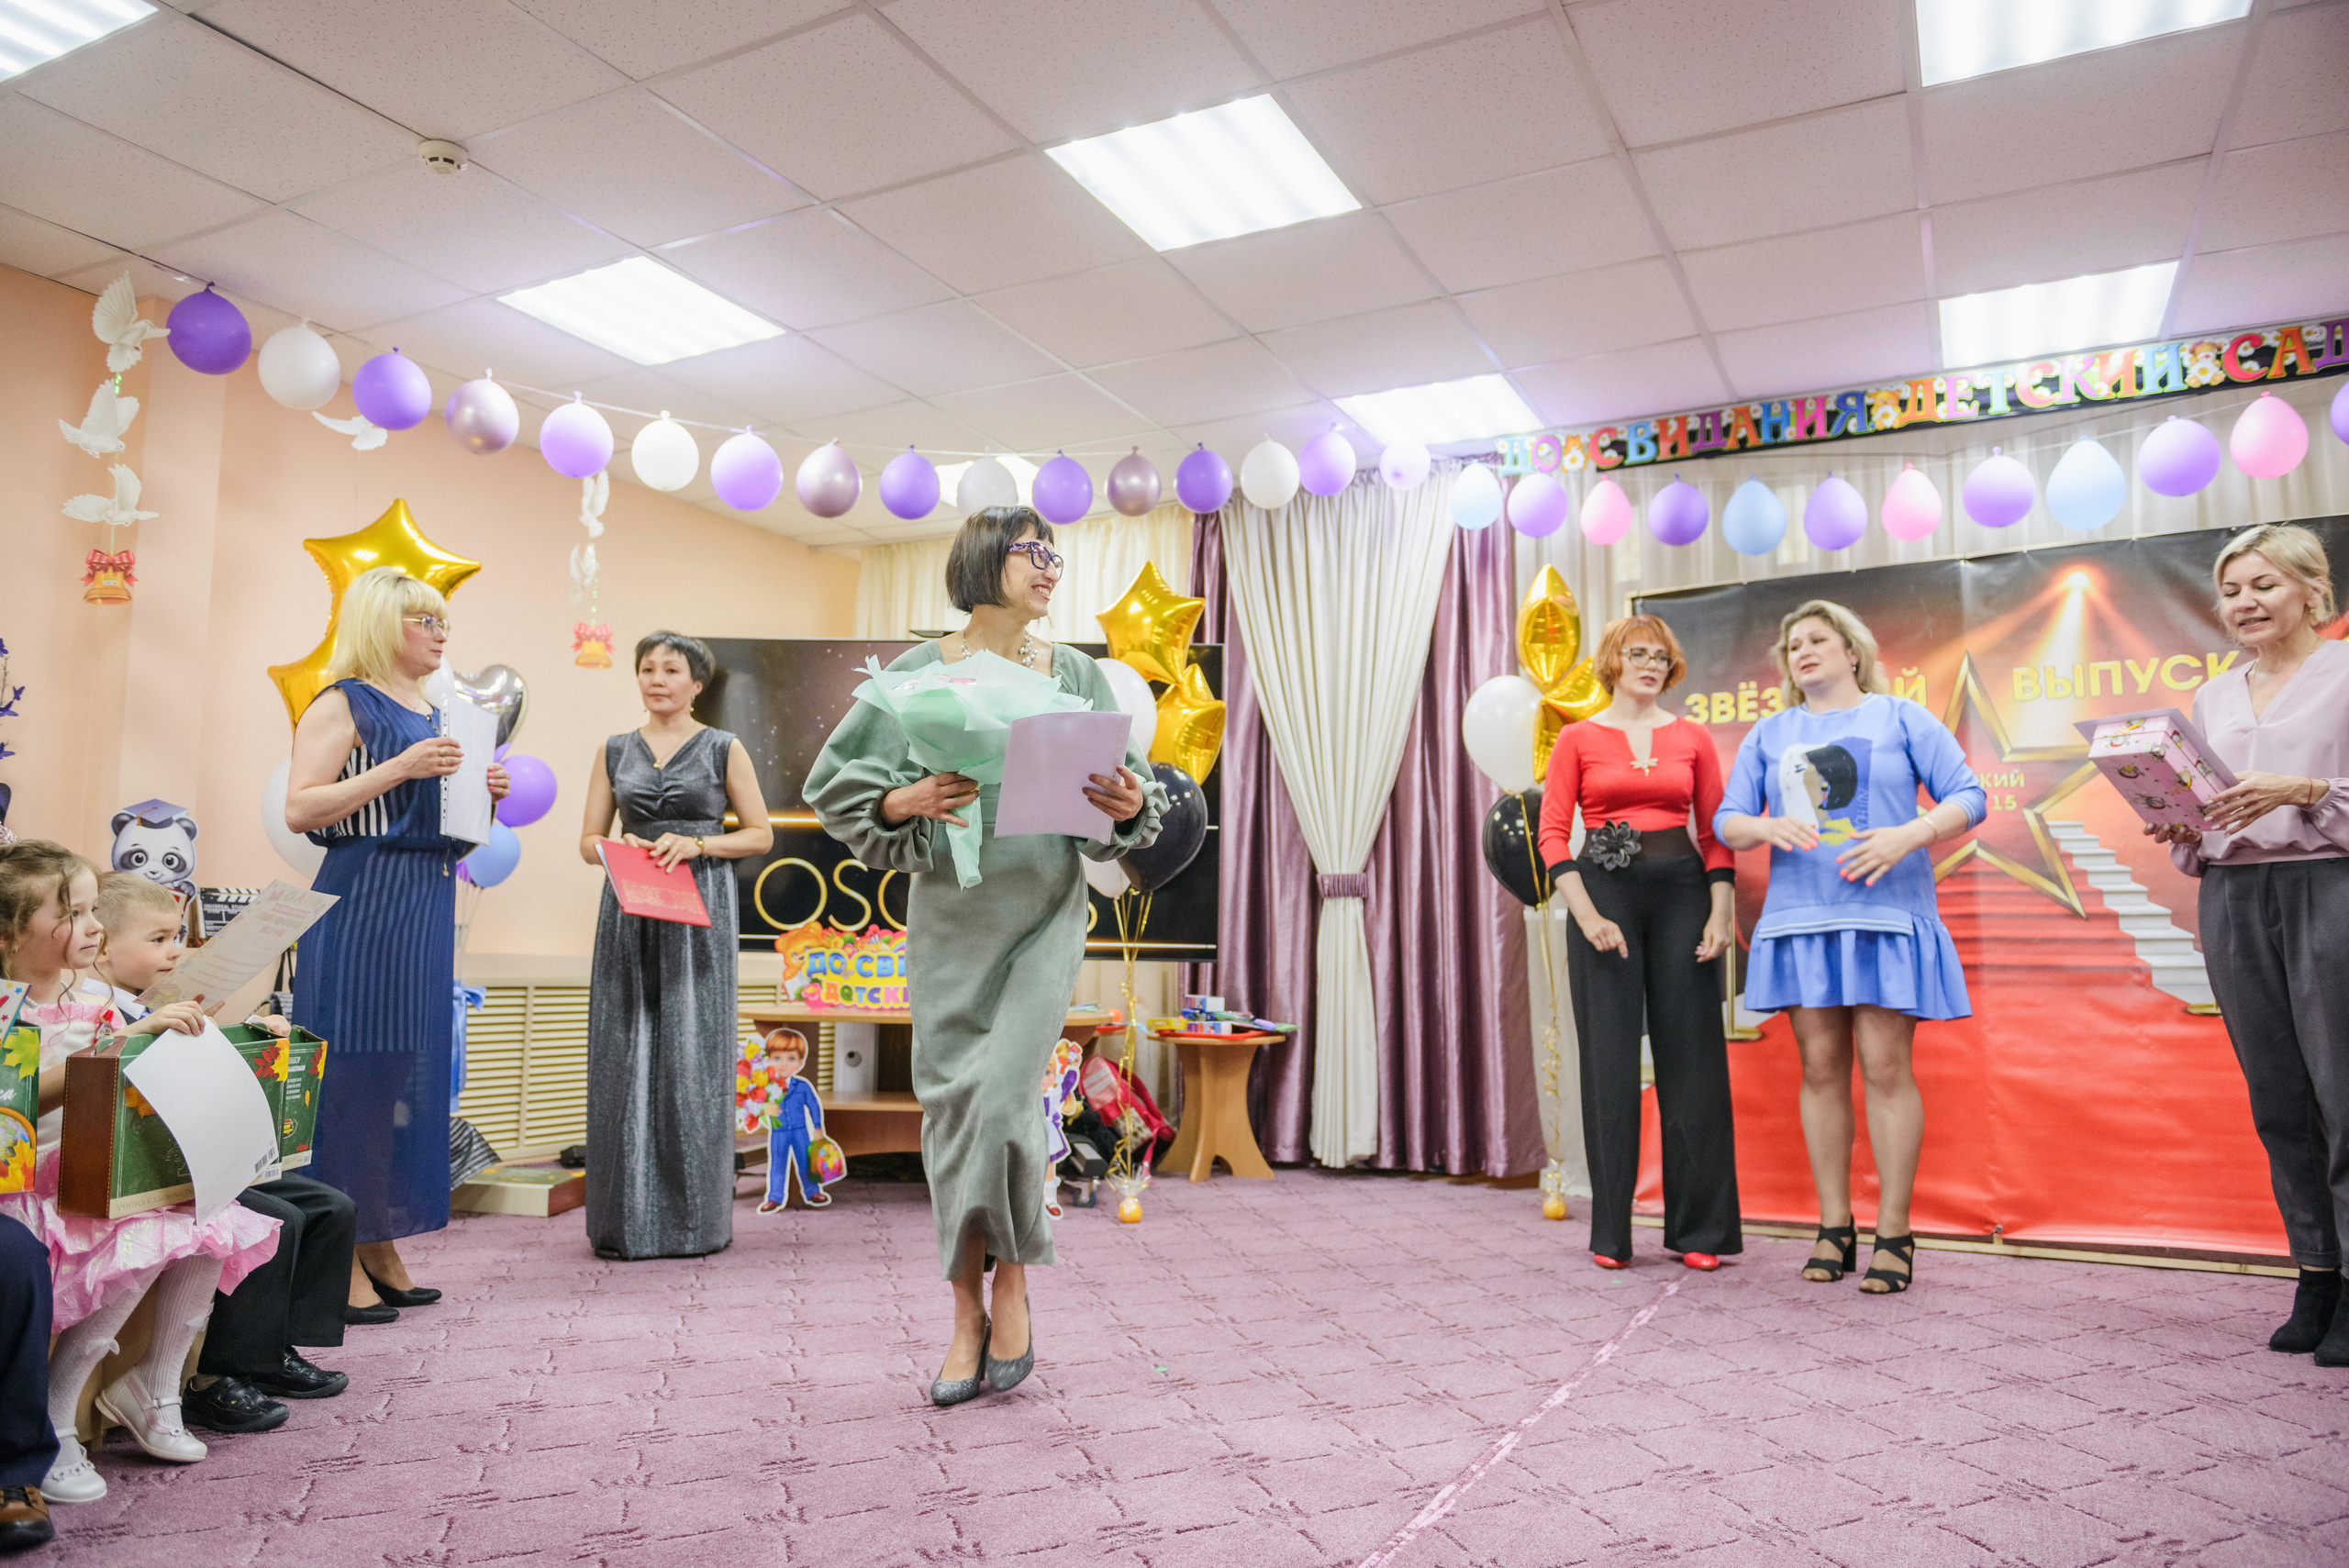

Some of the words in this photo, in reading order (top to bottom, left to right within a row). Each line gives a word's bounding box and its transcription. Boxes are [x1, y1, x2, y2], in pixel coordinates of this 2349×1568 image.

[1497, 434, 1561, 477] ДО
[1898, 342, 2188, 424] ДЕТСКИЙ
[2221, 317, 2349, 383] САД
[2012, 650, 2241, 703] ВЫПУСК
[1979, 768, 2025, 788] КИЙ
[1992, 795, 2018, 812] 15
[806, 951, 848, 978] ДО
